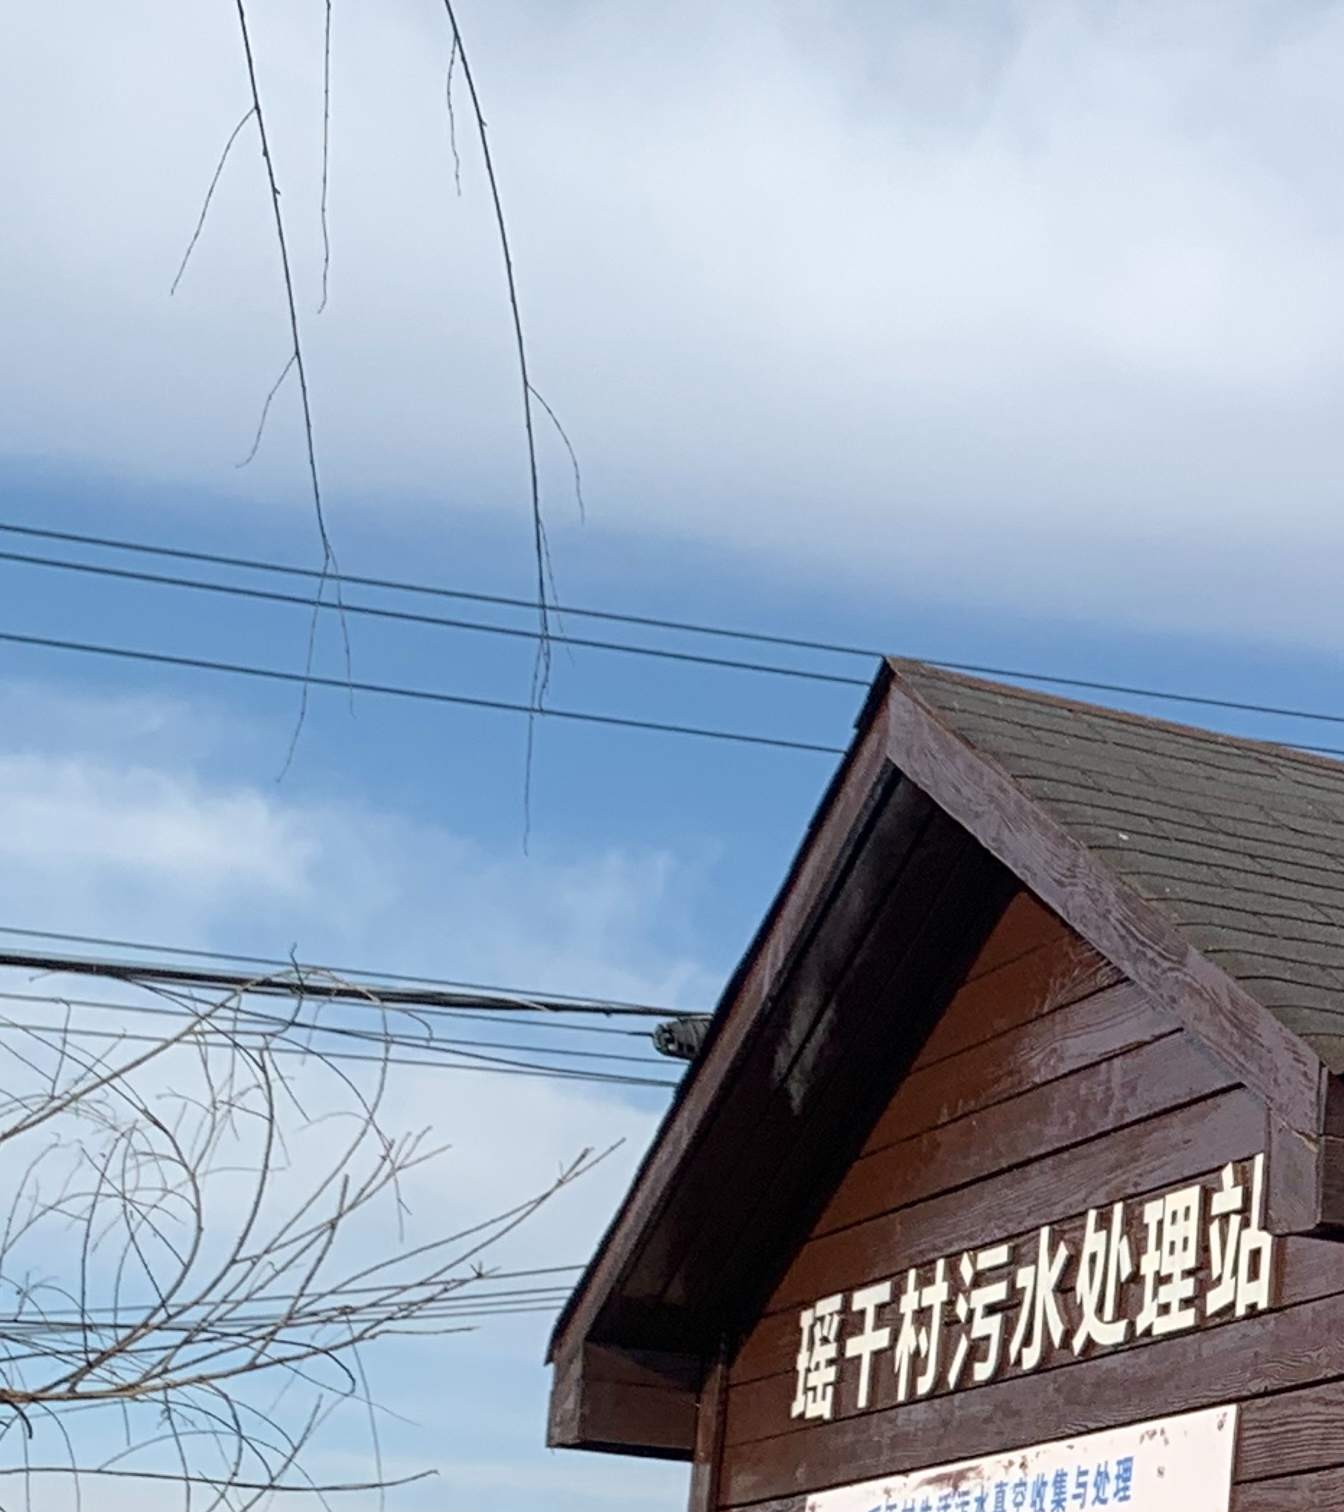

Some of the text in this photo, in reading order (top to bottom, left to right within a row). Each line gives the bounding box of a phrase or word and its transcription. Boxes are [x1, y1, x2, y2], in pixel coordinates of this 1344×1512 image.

[790, 1152, 1273, 1420] 瑶干村污水处理站
